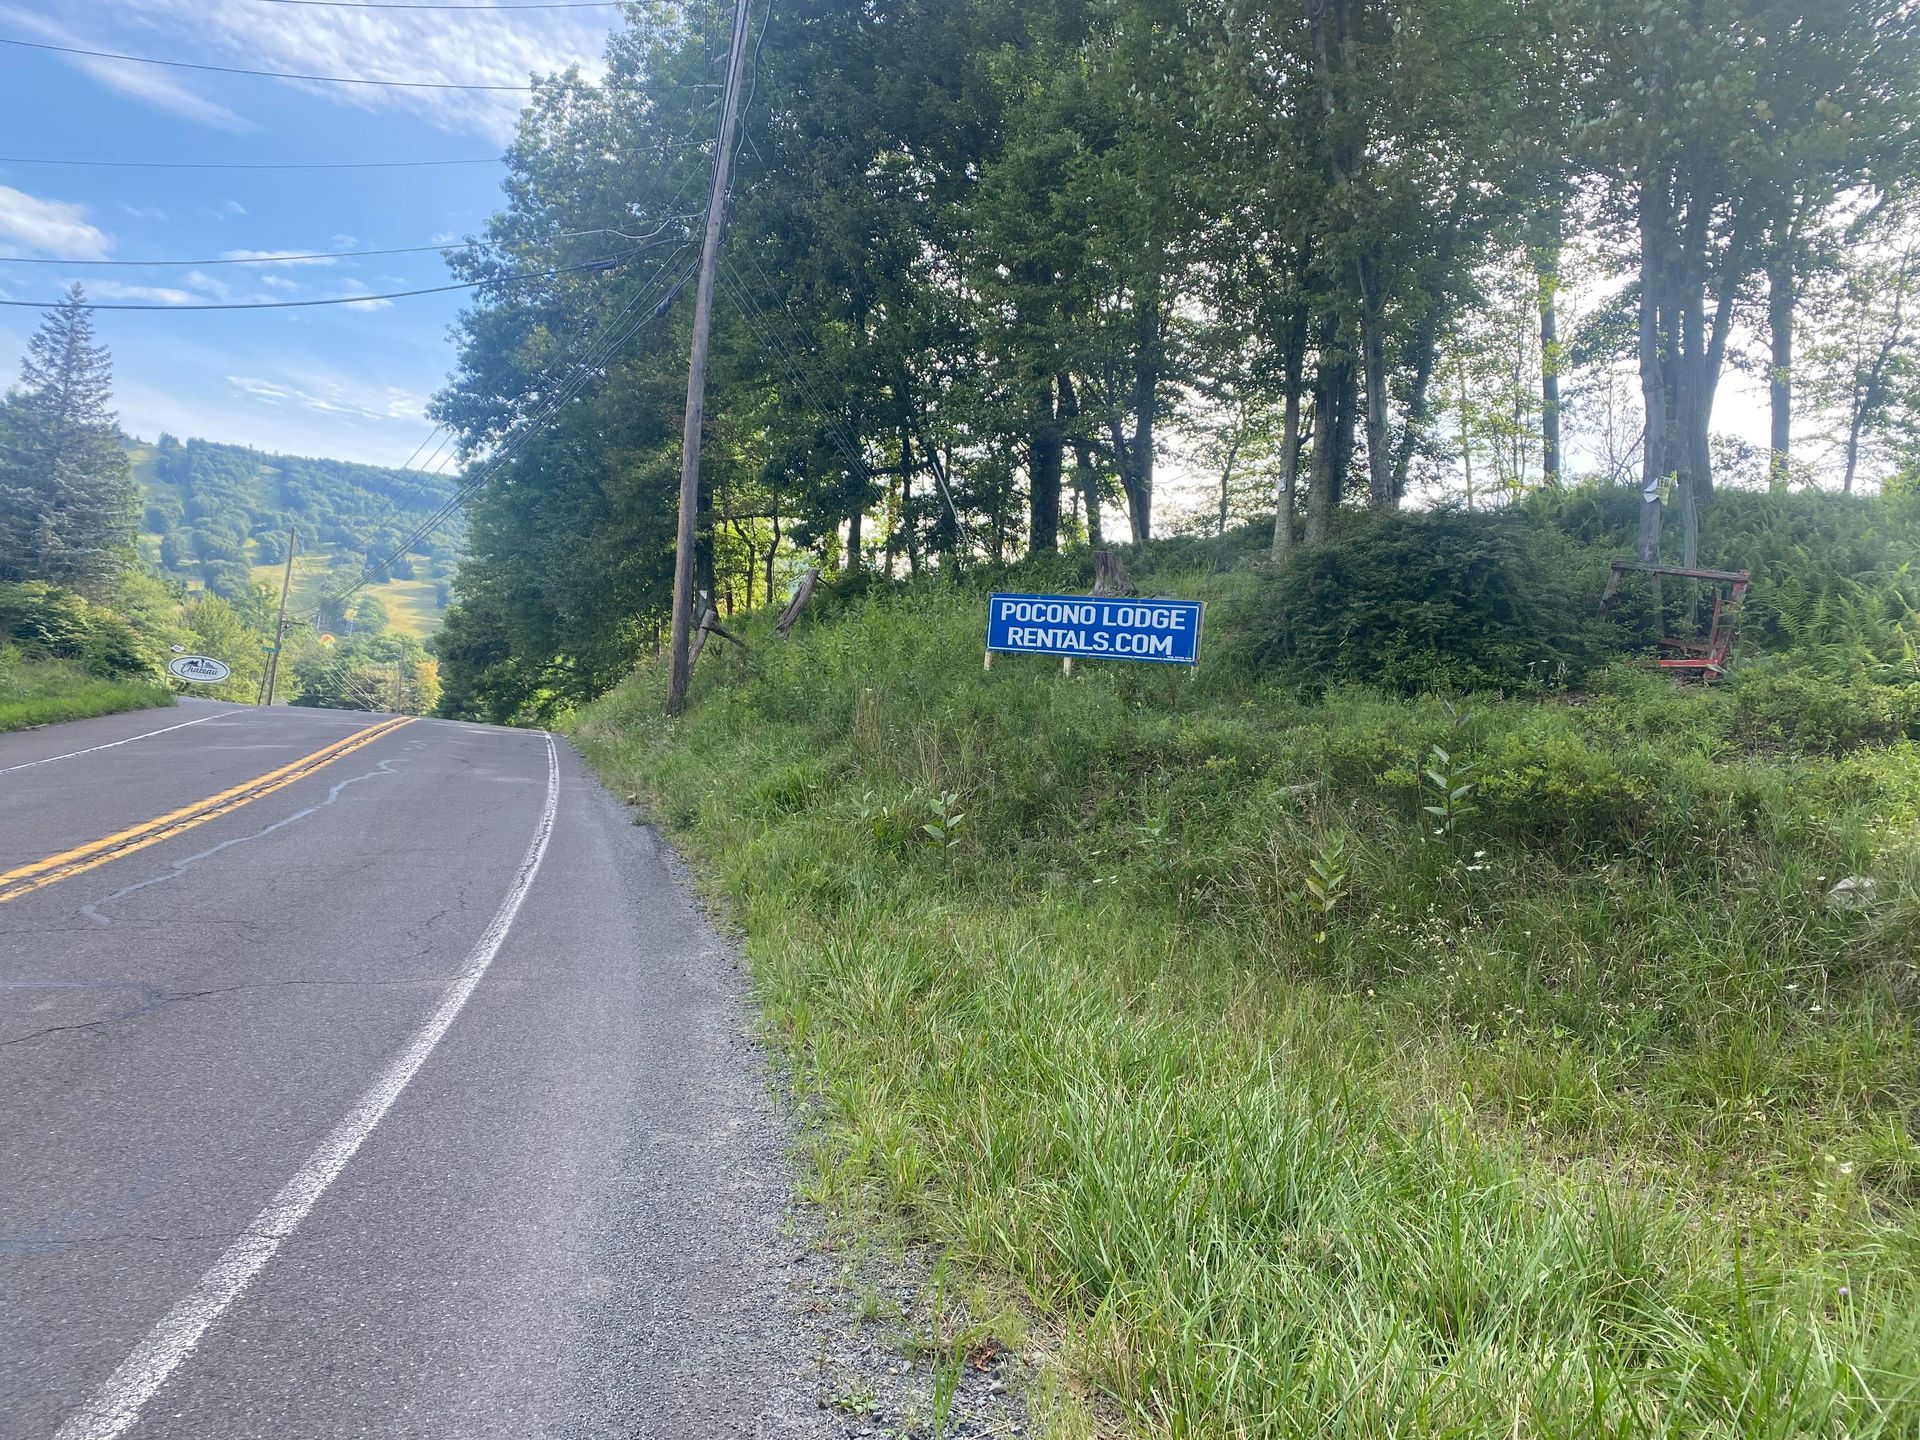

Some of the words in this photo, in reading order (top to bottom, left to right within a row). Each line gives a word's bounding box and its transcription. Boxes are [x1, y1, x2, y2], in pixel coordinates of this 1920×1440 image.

[1001, 602, 1096, 625] POCONO
[1102, 606, 1186, 630] LODGE
[1007, 626, 1173, 655] RENTALS.COM
[181, 663, 218, 675] Chateau
